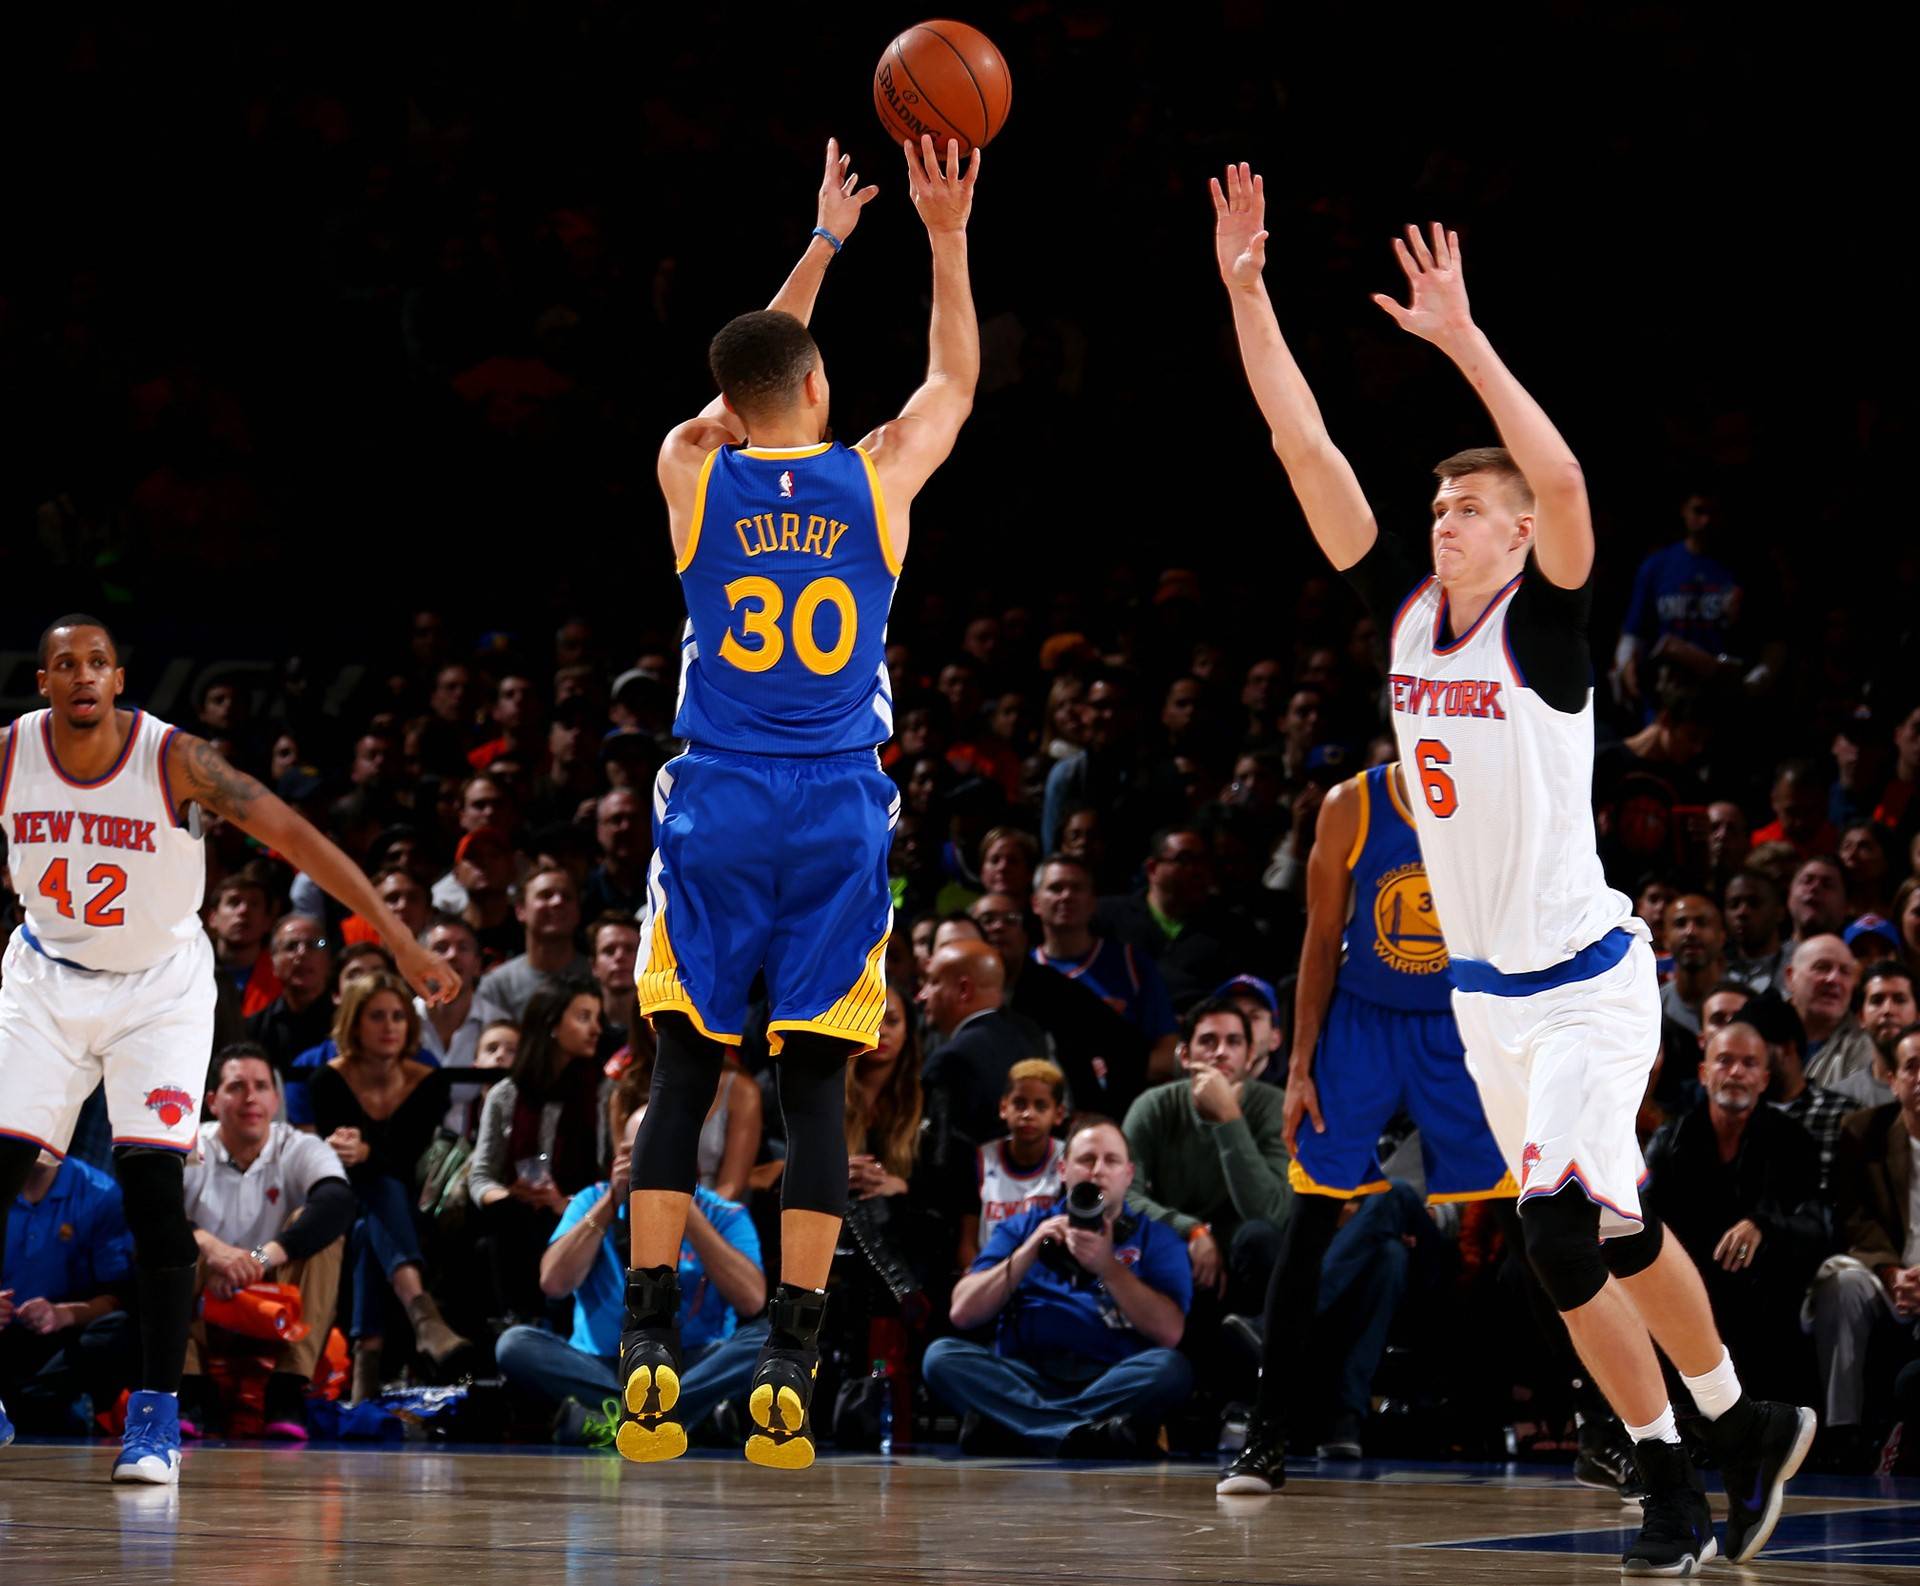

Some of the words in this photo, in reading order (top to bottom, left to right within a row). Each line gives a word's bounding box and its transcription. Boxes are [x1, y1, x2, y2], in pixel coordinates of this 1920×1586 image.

[734, 512, 849, 559] CURRY
[719, 575, 859, 676] 30
[1387, 673, 1428, 715] EW
[1425, 679, 1506, 720] YORK
[1414, 738, 1459, 819] 6
[13, 811, 75, 844] NEW
[78, 812, 156, 853] YORK
[38, 857, 128, 927] 42
[1376, 862, 1427, 888] GOLDE
